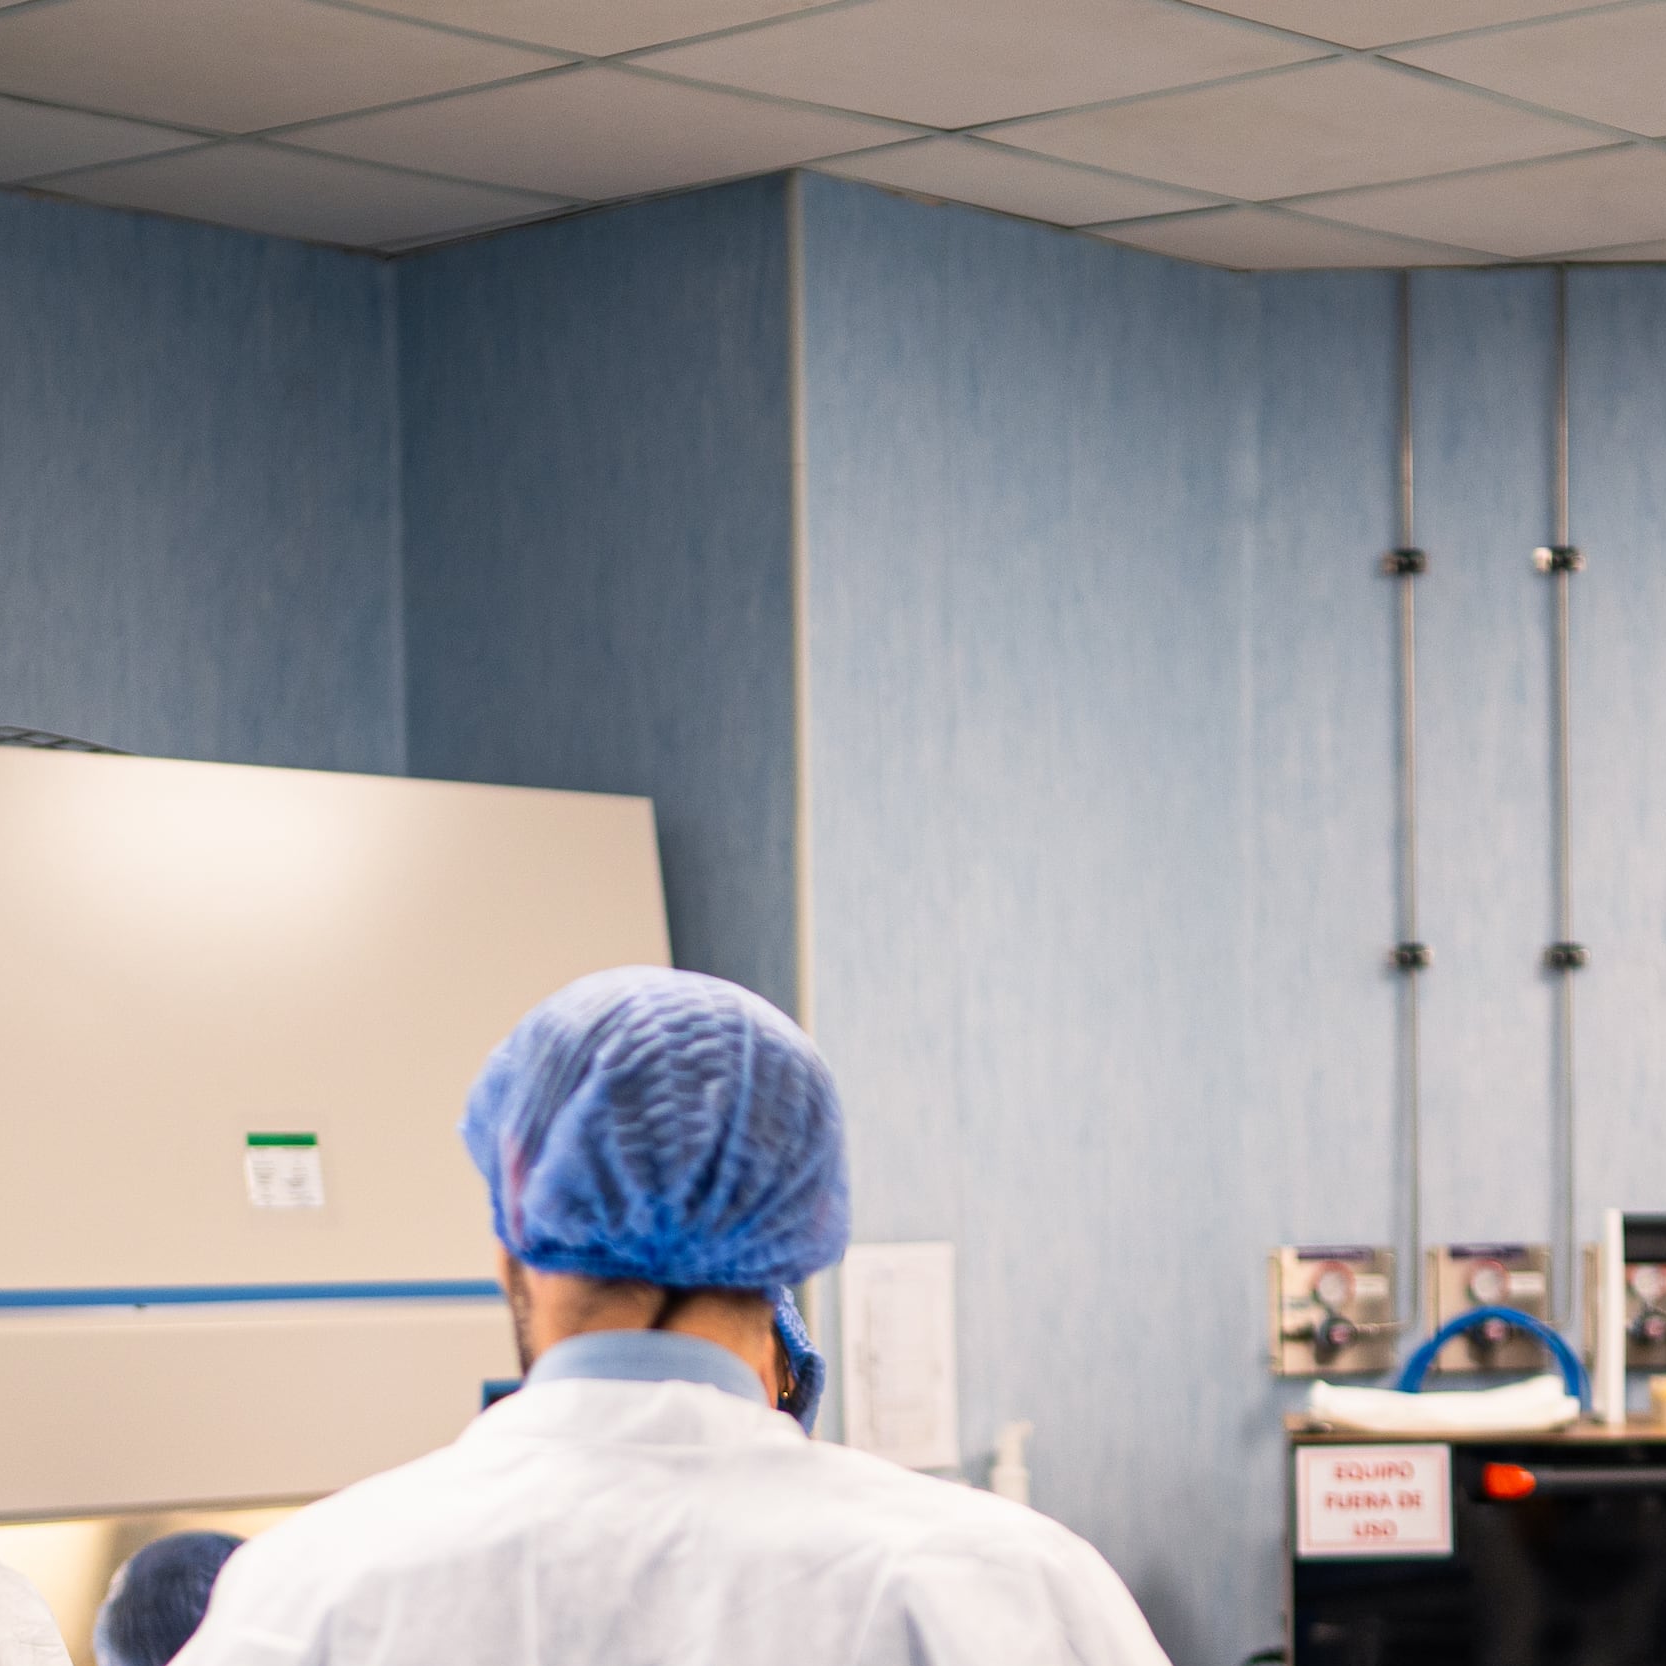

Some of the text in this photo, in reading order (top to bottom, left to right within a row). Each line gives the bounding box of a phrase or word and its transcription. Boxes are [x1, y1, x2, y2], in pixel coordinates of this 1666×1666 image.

[1335, 1461, 1415, 1481] EQUIPO
[1325, 1489, 1422, 1510] FUERA DE
